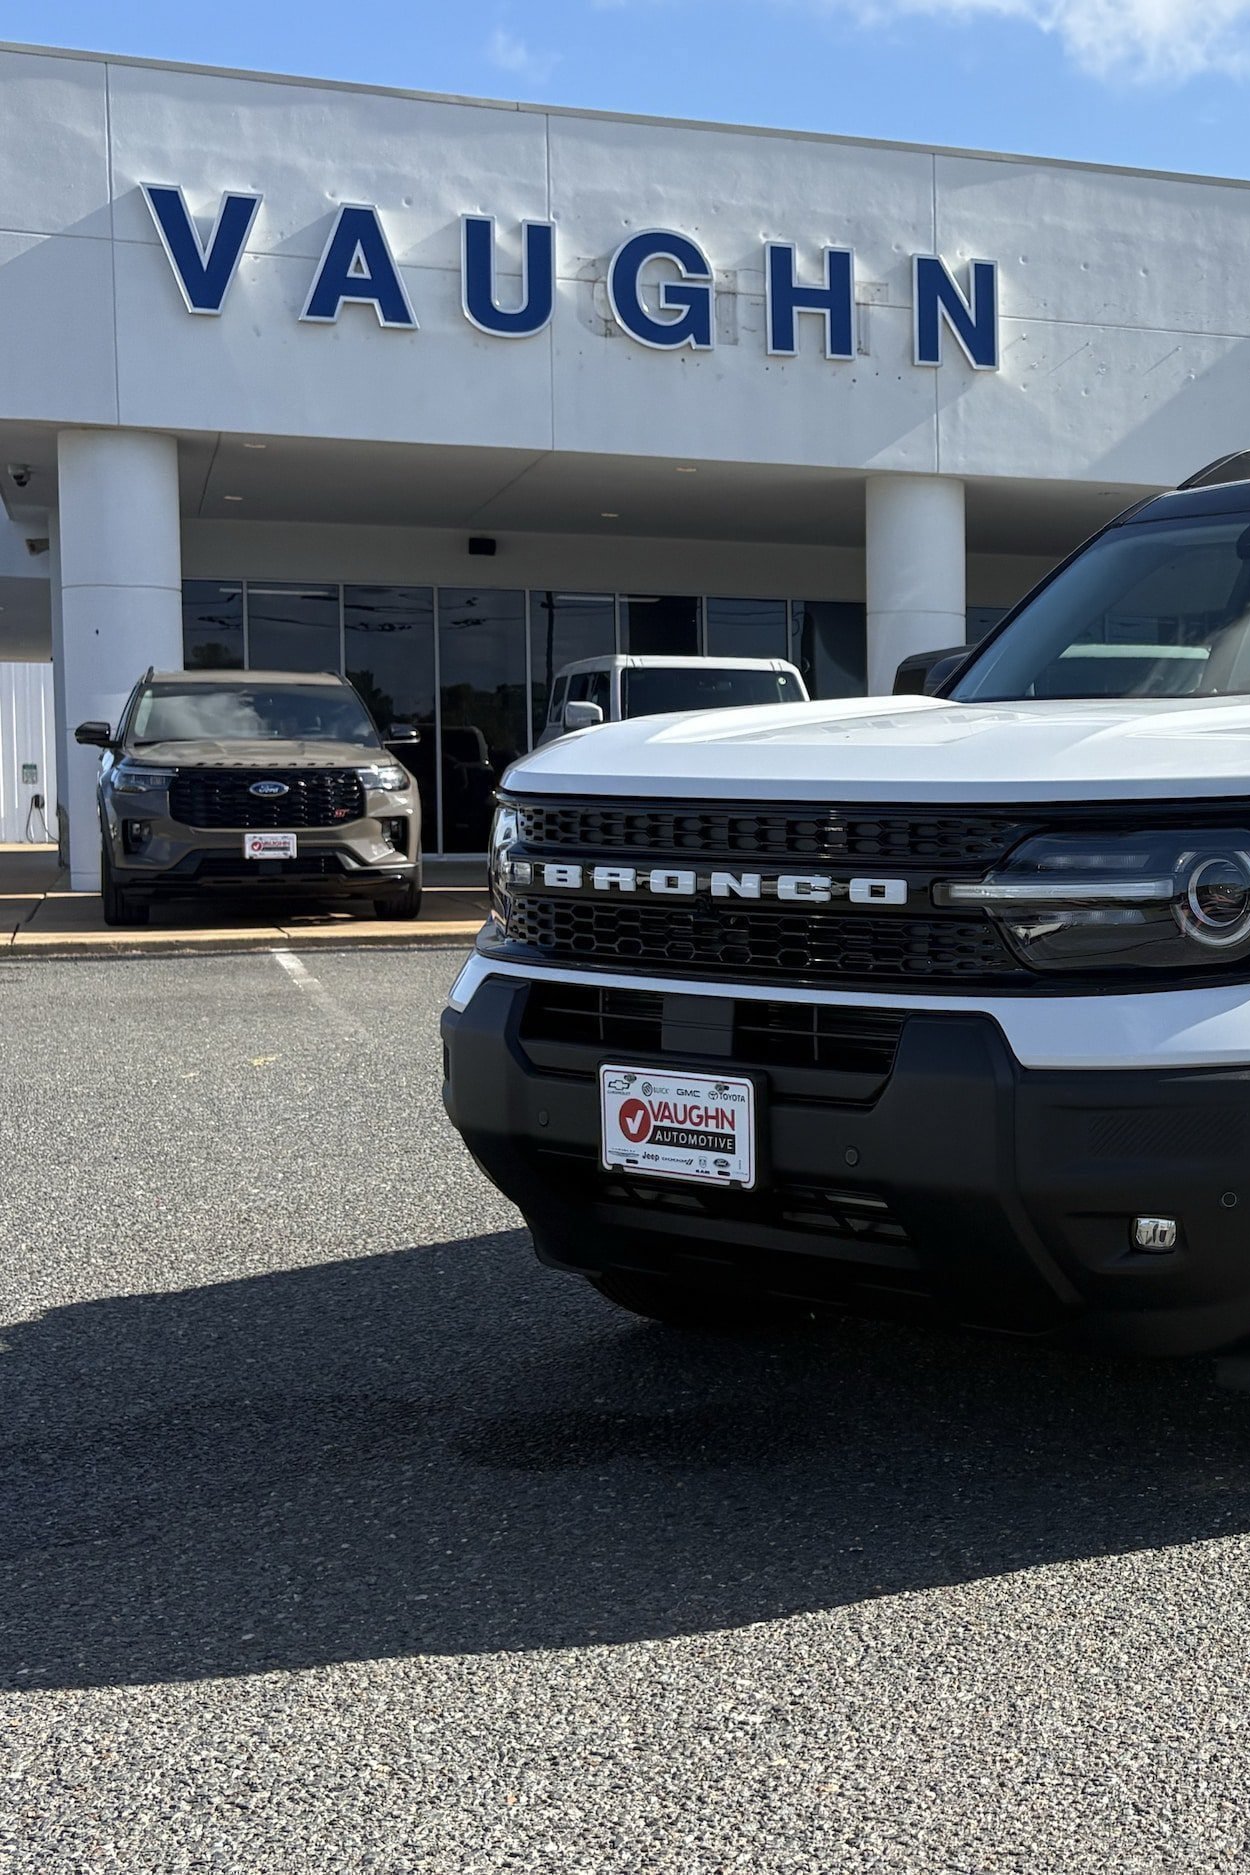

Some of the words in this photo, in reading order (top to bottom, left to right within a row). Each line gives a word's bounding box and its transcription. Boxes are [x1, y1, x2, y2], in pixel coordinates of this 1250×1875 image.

[140, 182, 1000, 371] VAUGHN
[544, 864, 908, 905] BRONCO
[676, 1088, 701, 1098] GMC
[719, 1092, 746, 1103] TOYOTA
[648, 1099, 735, 1131] VAUGHN
[655, 1129, 733, 1150] AUTOMOTIVE
[642, 1151, 660, 1162] Jeep
